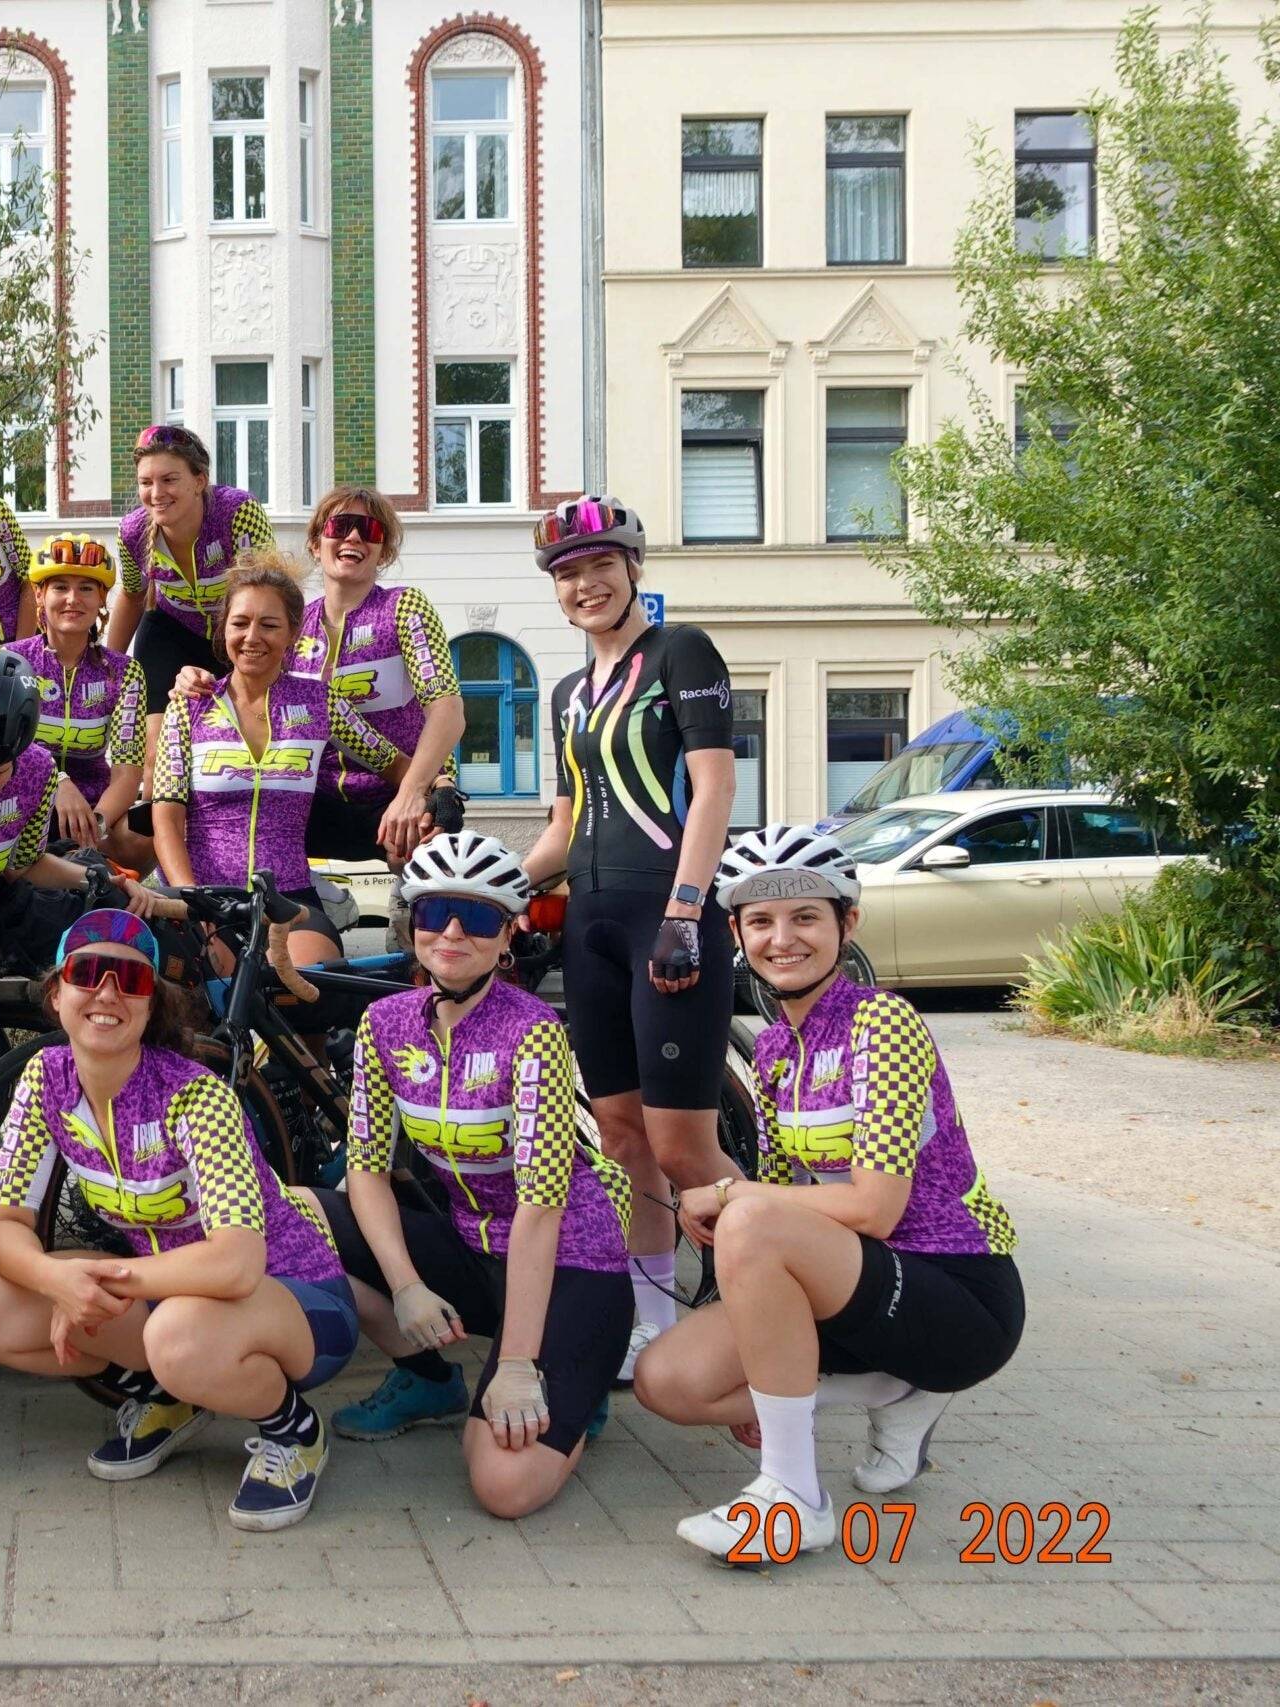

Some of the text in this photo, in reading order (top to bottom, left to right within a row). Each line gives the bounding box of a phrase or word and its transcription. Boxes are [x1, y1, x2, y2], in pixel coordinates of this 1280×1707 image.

[34, 722, 107, 750] RIS
[372, 877, 398, 885] Perso
[517, 1062, 536, 1162] IRIS
